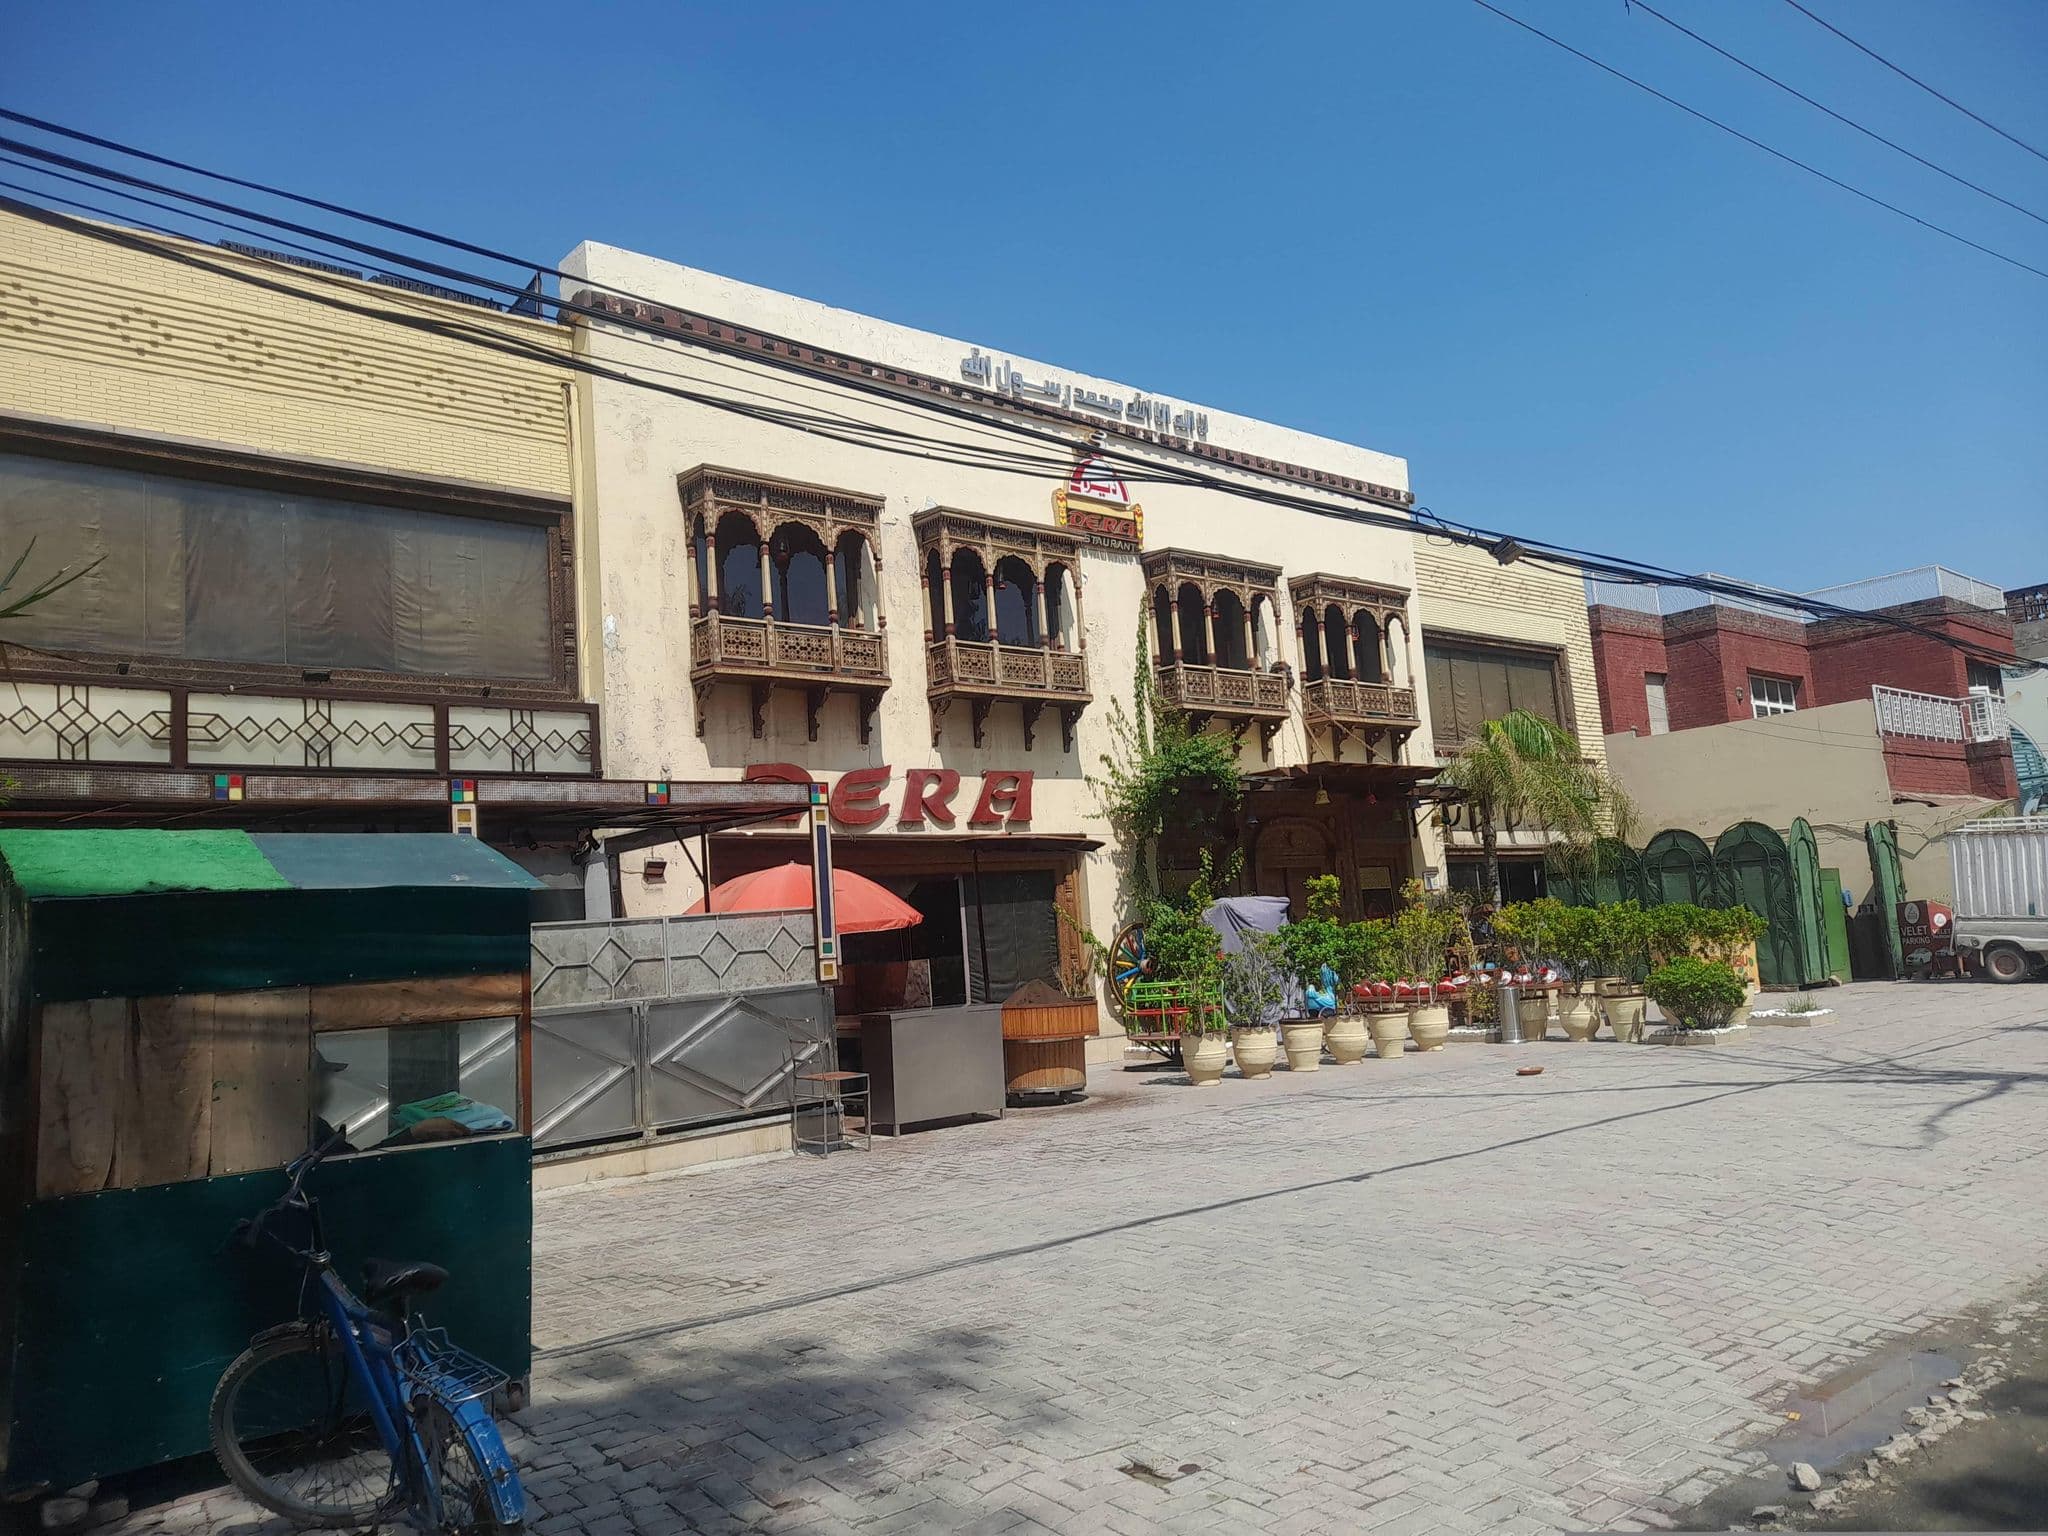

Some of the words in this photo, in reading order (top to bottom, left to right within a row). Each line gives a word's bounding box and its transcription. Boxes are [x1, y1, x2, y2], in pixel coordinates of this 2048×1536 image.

[960, 347, 991, 378] الله
[995, 360, 1071, 409] رسول
[1074, 387, 1123, 414] محمد
[1126, 393, 1152, 421] الله
[1196, 412, 1208, 435] لا
[1069, 509, 1136, 536] DERA
[1084, 534, 1137, 552] STAURANT
[1901, 925, 1928, 936] VELET
[1902, 936, 1931, 945] PARKING
